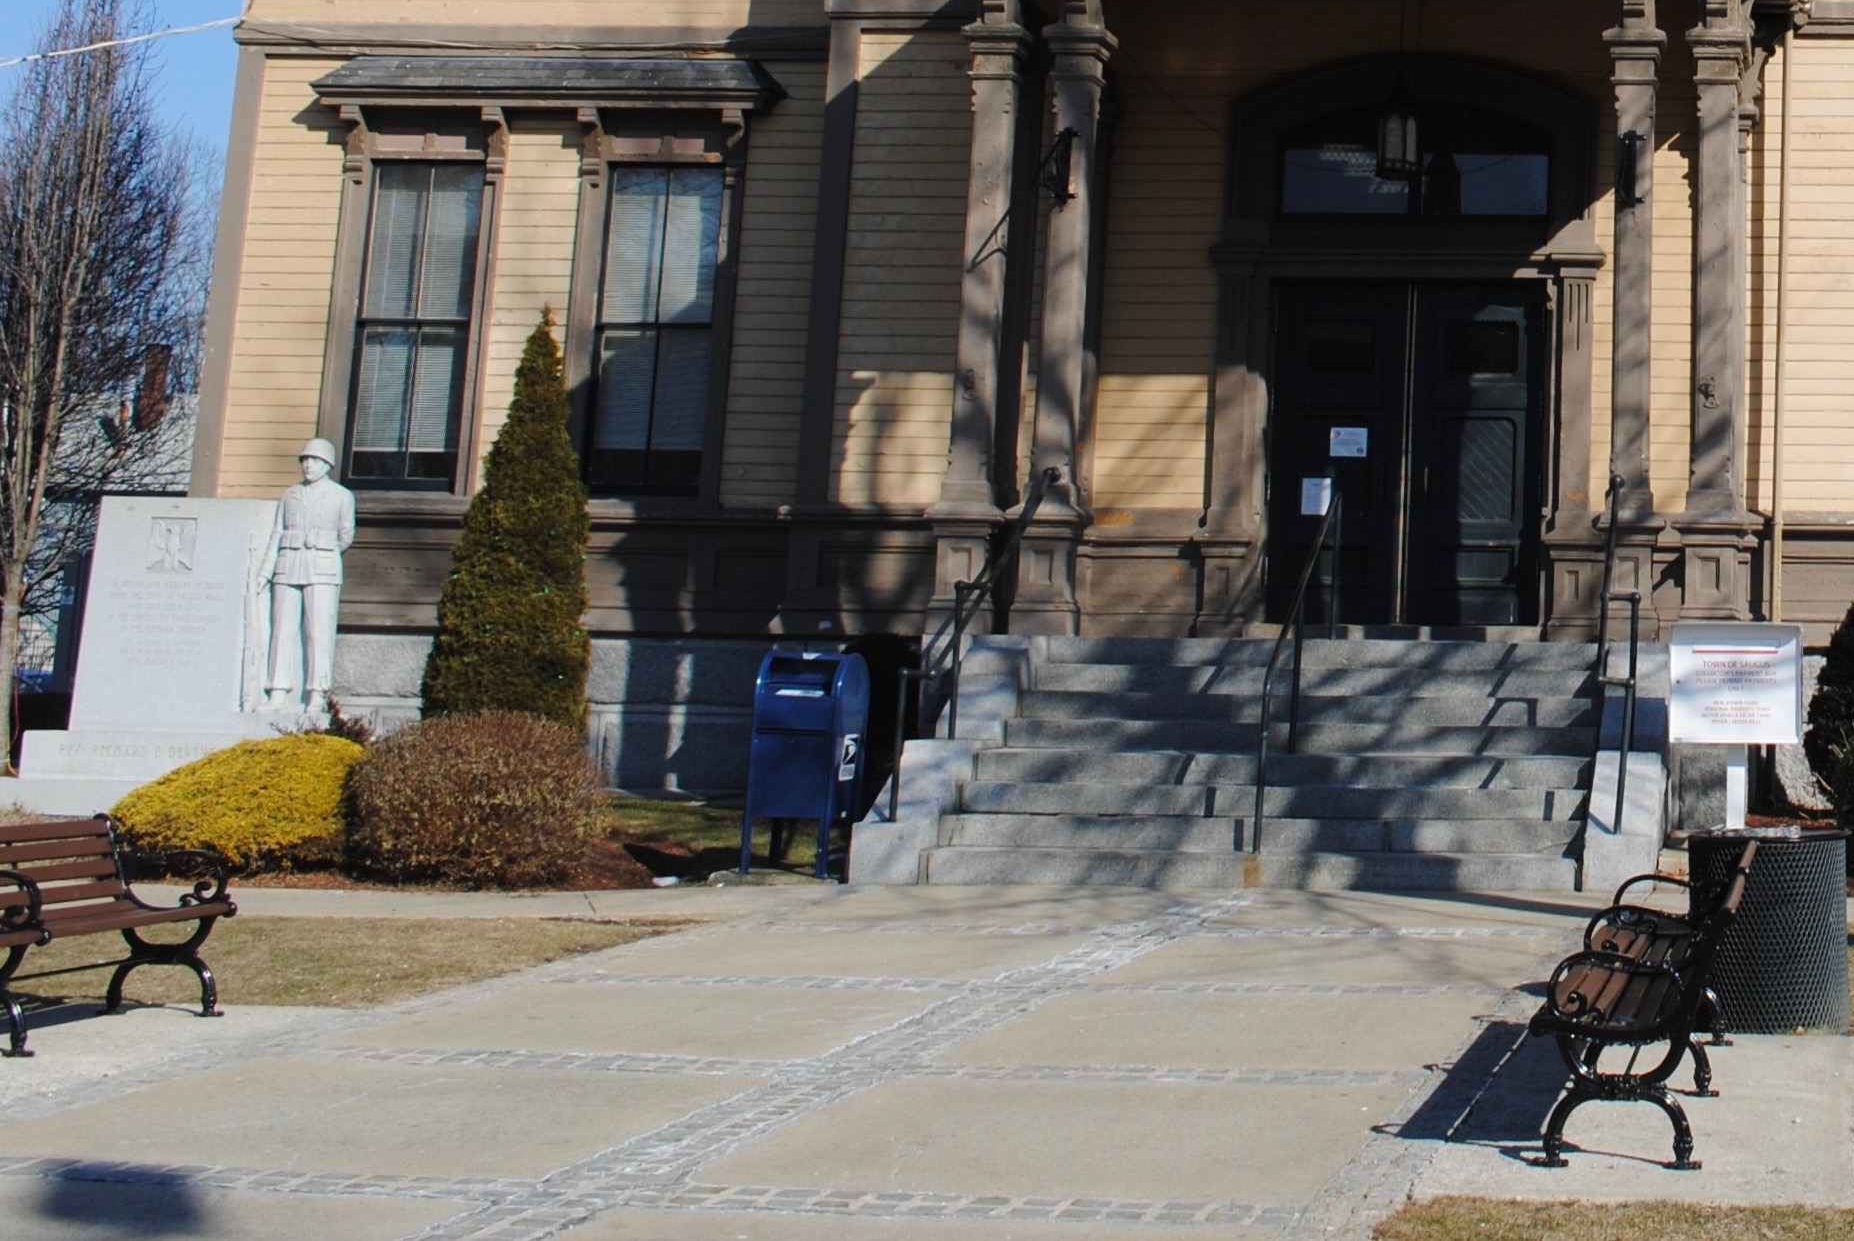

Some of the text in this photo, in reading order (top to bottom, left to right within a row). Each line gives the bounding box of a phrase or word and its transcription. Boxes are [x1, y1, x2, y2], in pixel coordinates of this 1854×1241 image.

[1703, 660, 1771, 669] TOWN OF SAUGUS
